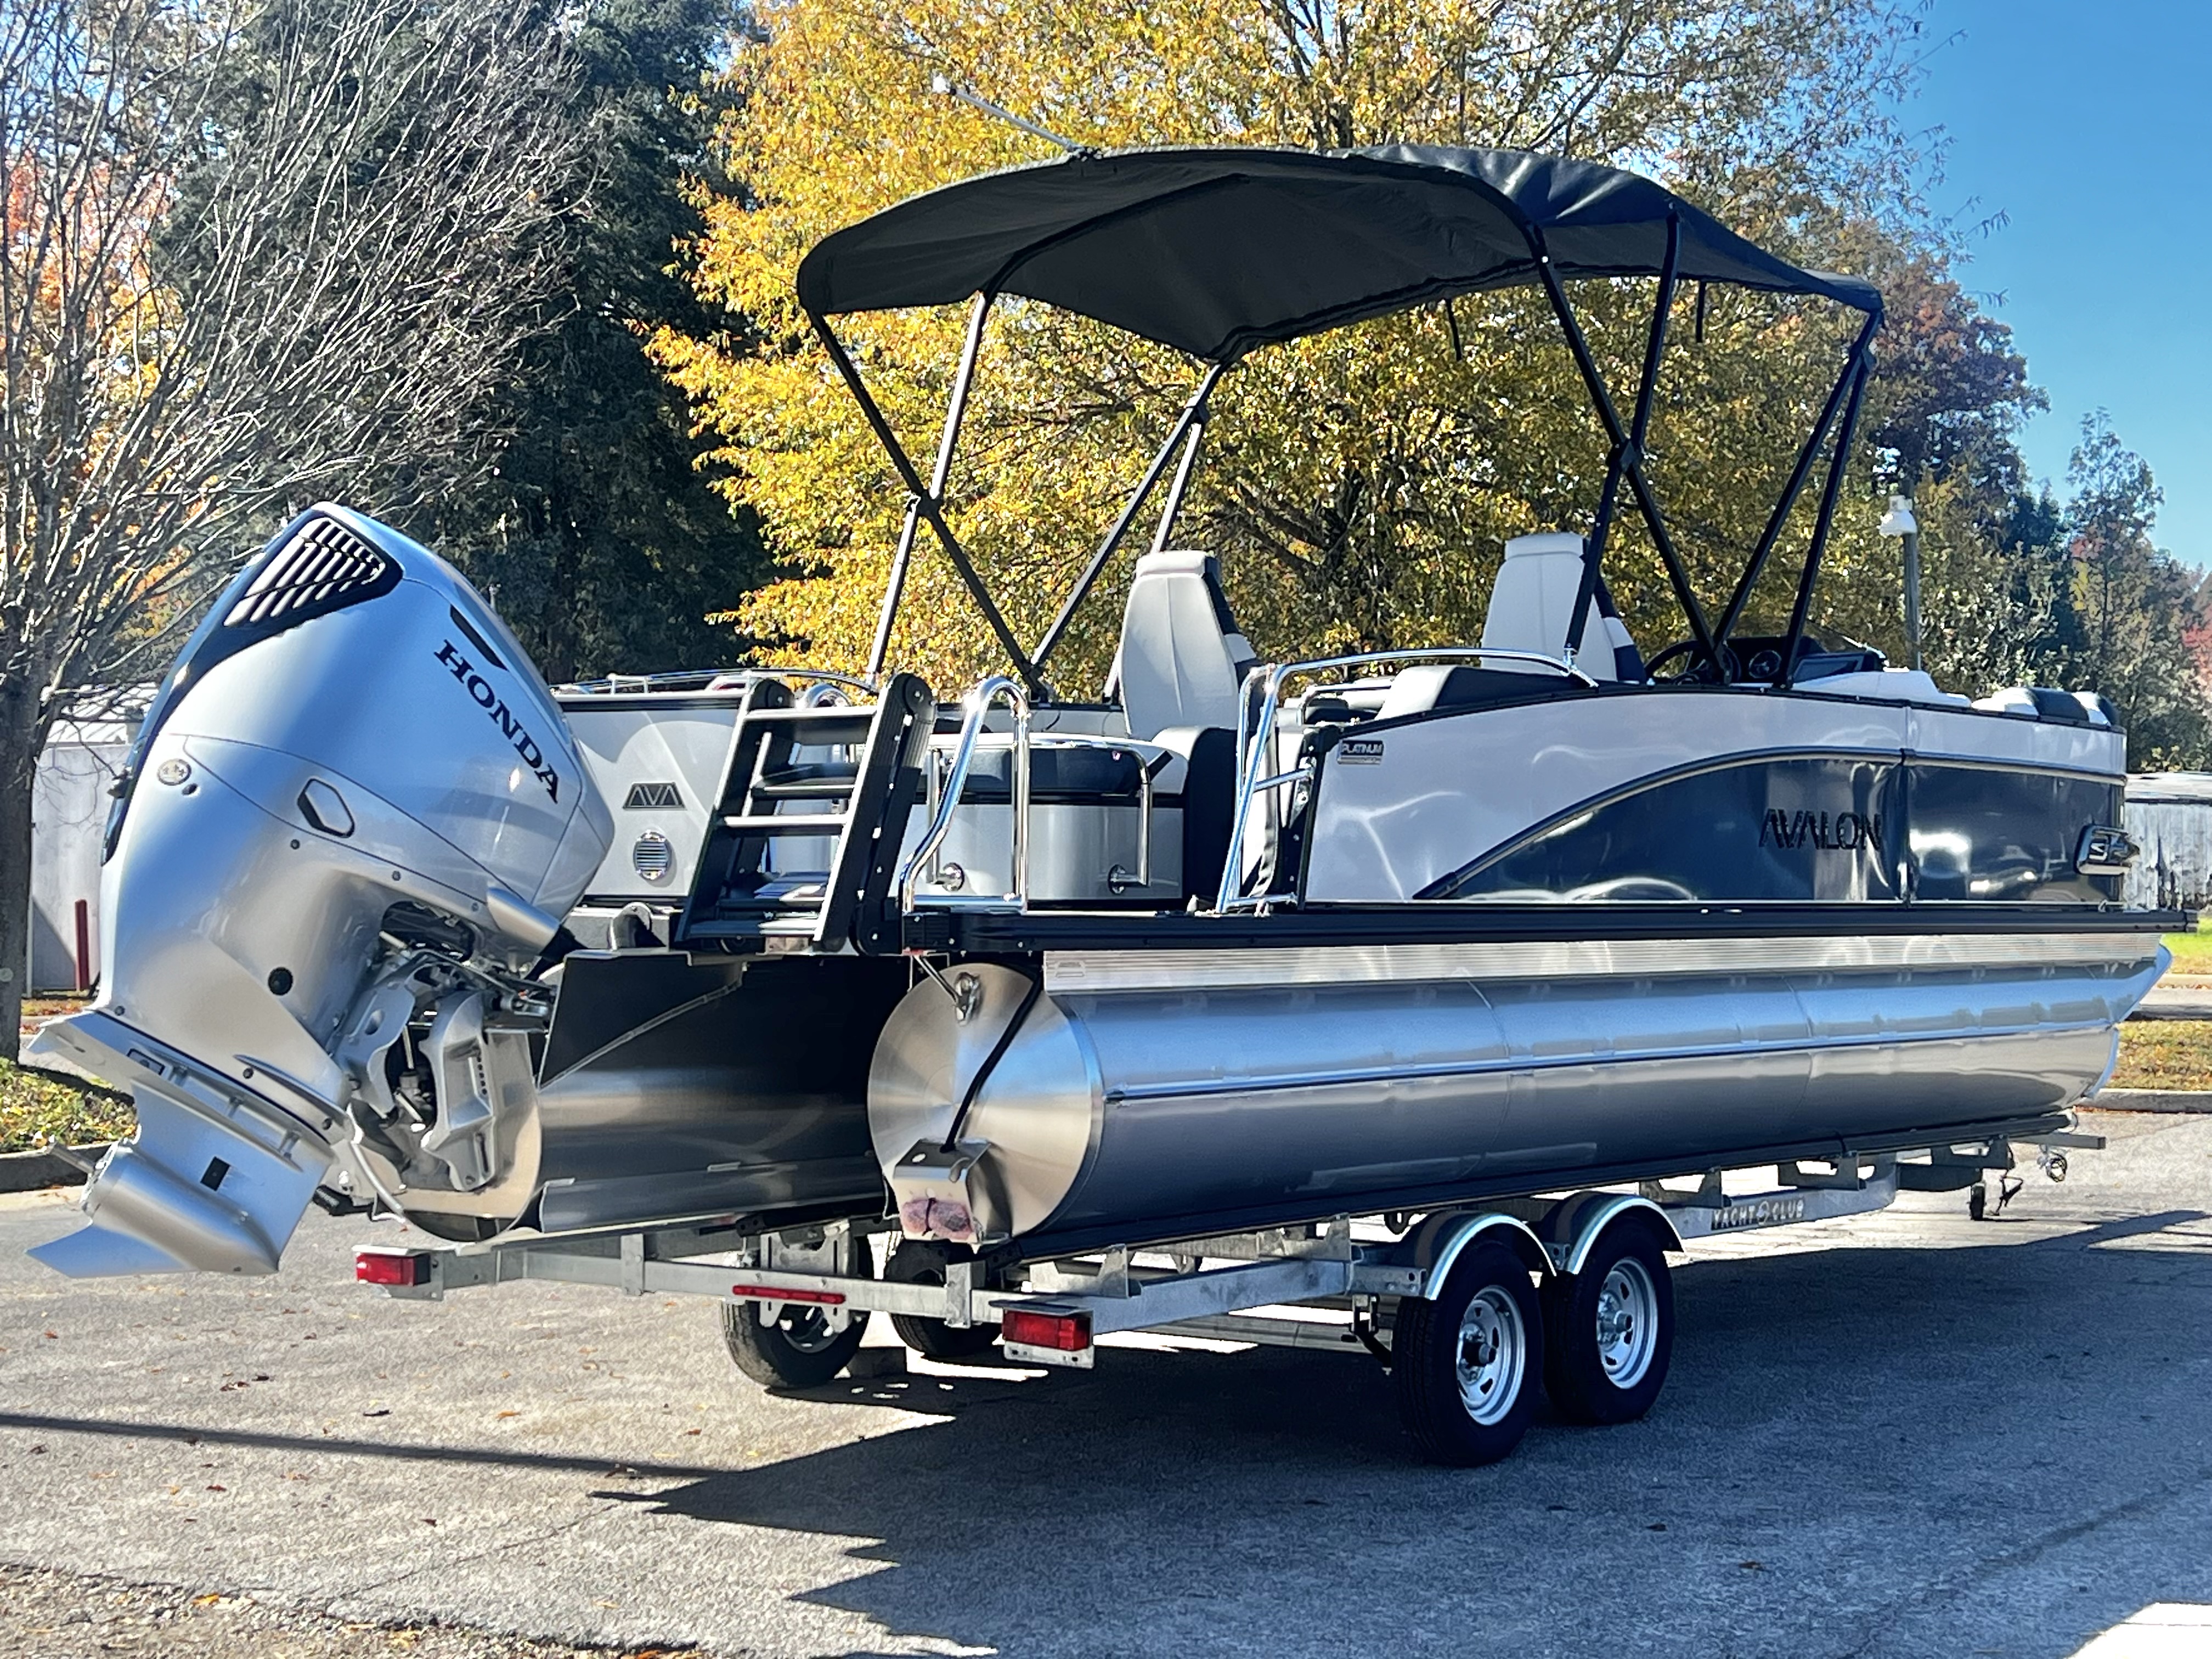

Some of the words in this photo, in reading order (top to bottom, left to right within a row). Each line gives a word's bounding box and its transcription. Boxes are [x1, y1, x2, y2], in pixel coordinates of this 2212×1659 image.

[433, 639, 559, 804] HONDA
[1341, 743, 1383, 754] PLATINUM
[1759, 809, 1882, 850] AVALON
[1713, 1205, 1756, 1229] YACHT
[1772, 1199, 1804, 1221] CLUB
